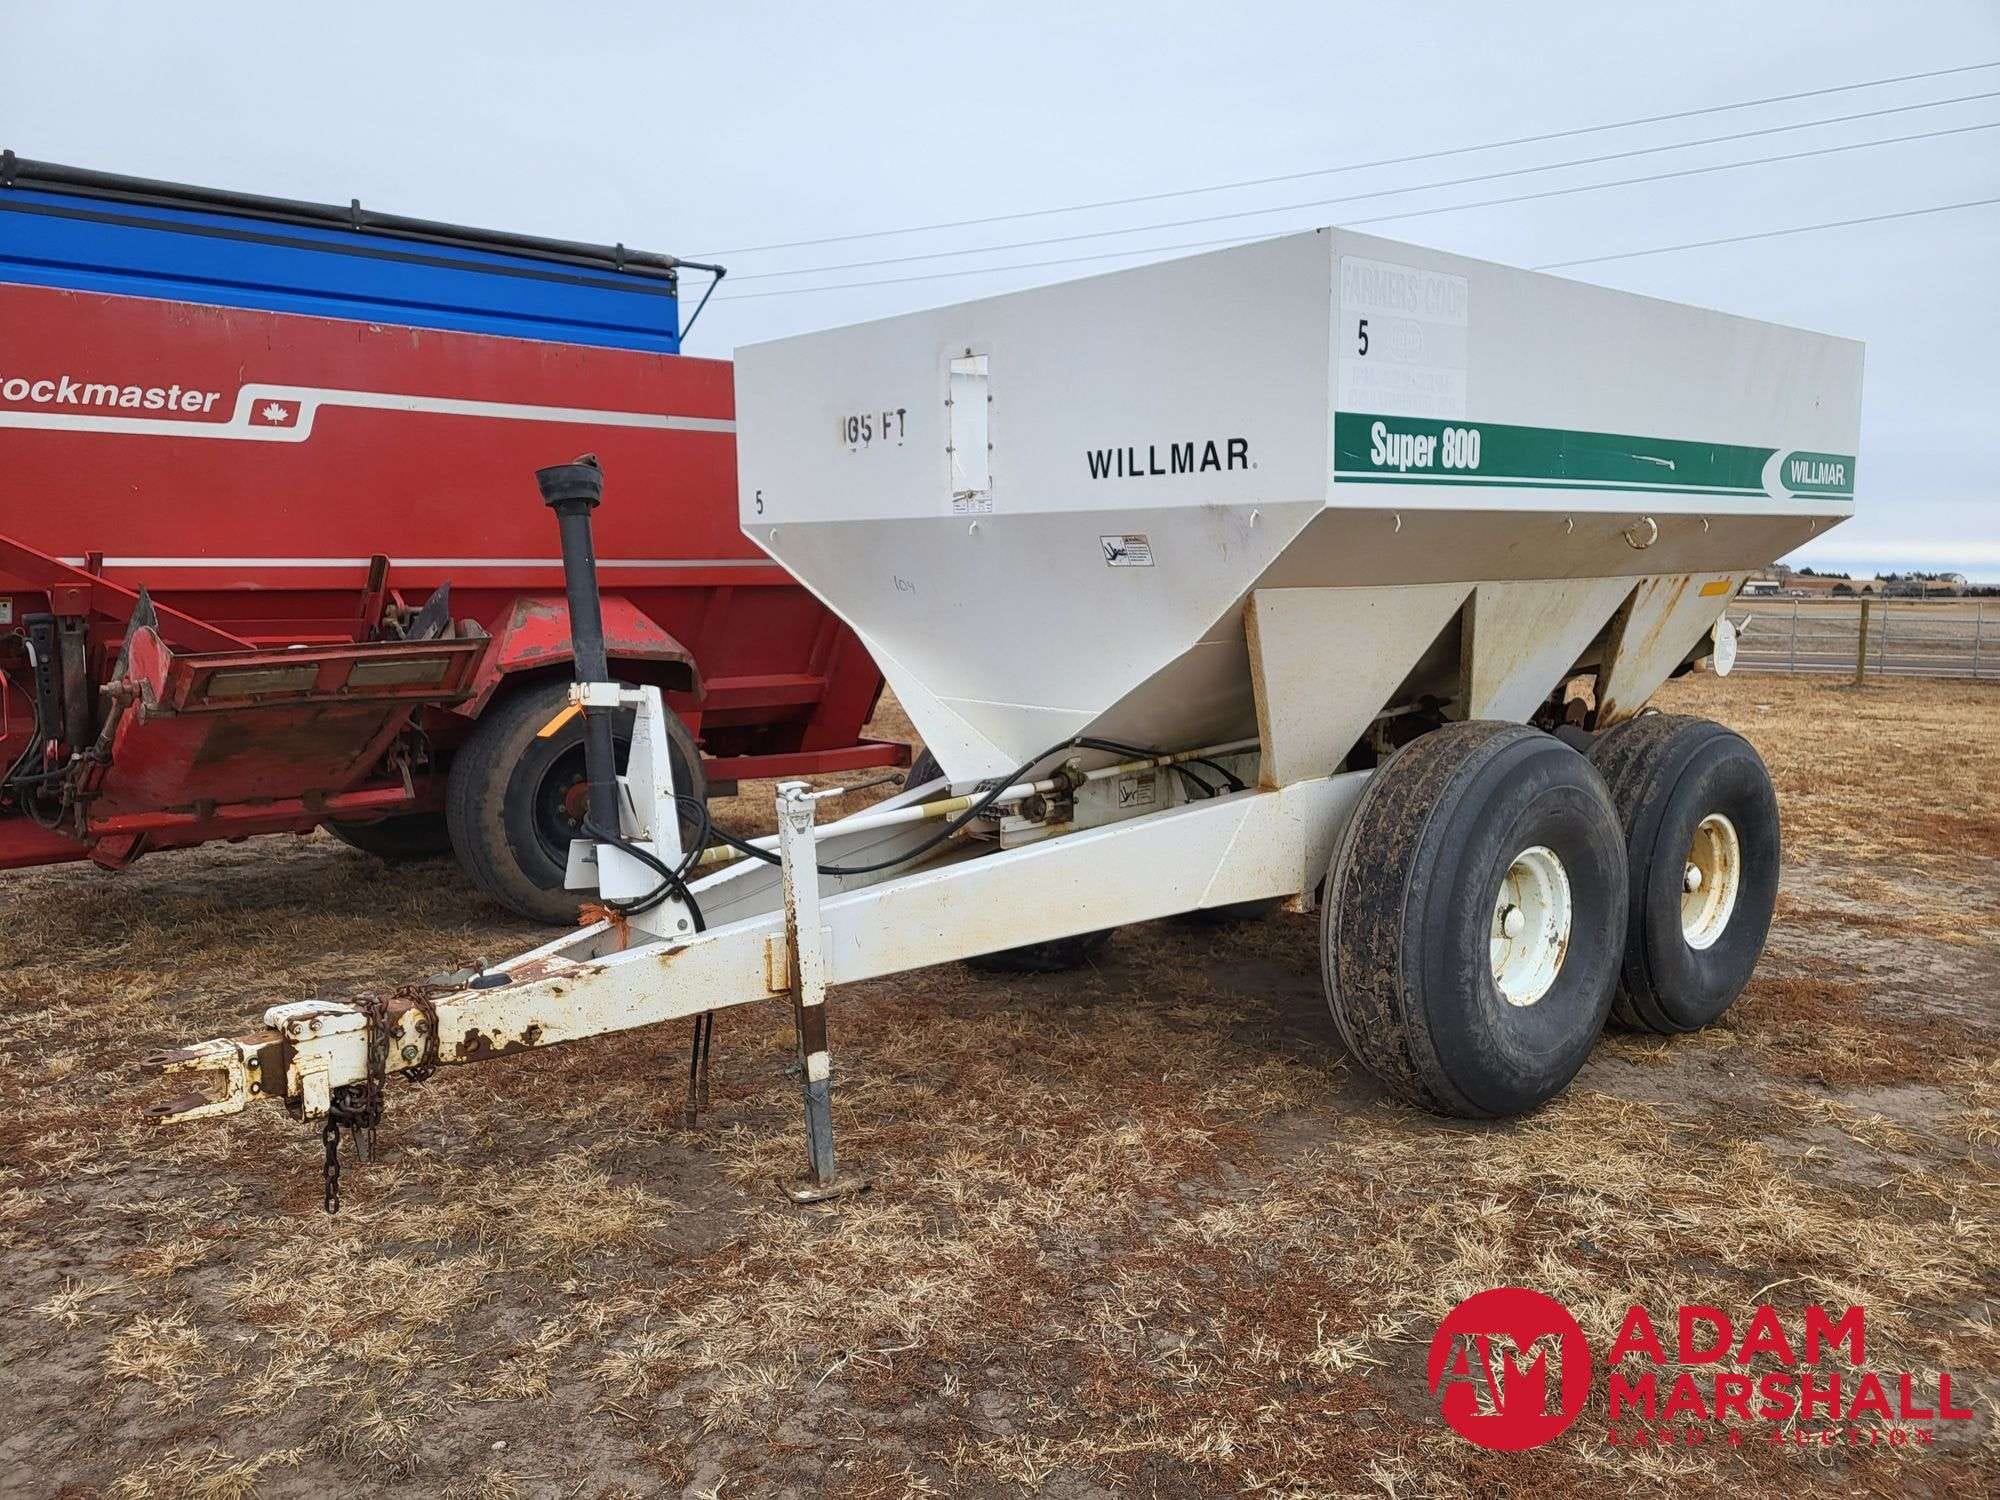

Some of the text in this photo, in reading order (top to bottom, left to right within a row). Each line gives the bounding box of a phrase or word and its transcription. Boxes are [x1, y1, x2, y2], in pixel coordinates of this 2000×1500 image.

[1357, 319, 1369, 356] 5
[0, 375, 221, 413] ockmaster
[882, 408, 907, 440] FT
[1087, 437, 1249, 480] WILLMAR
[1370, 421, 1481, 472] Super 800
[1790, 460, 1845, 486] WILLMAR
[756, 490, 764, 515] 5
